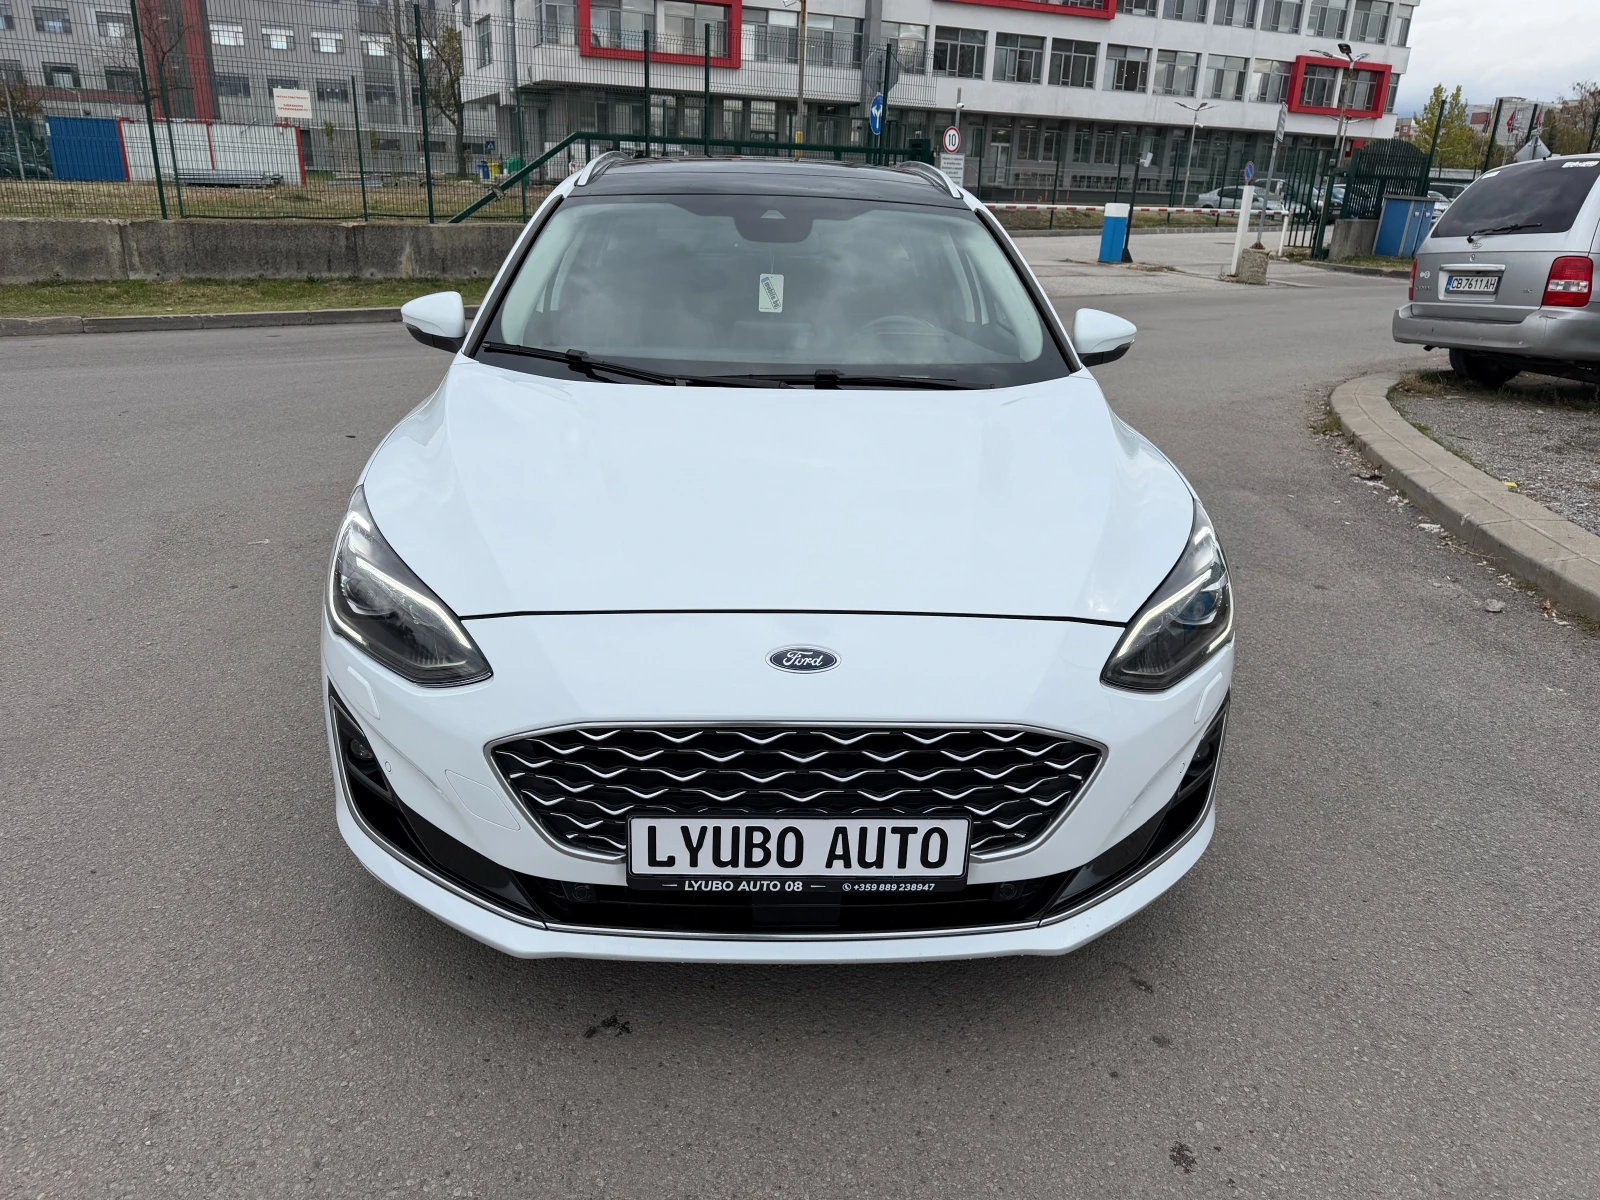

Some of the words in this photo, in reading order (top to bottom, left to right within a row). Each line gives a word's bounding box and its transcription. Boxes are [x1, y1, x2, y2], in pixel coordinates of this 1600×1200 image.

[948, 133, 957, 147] 10
[782, 650, 824, 666] Ford
[647, 825, 805, 869] LYUBO
[824, 826, 949, 869] AUTO
[684, 880, 734, 892] LYUBO
[737, 880, 781, 892] AUTO
[784, 881, 803, 892] 08
[853, 883, 877, 892] +359
[878, 883, 897, 892] 889
[898, 883, 935, 892] 238947
